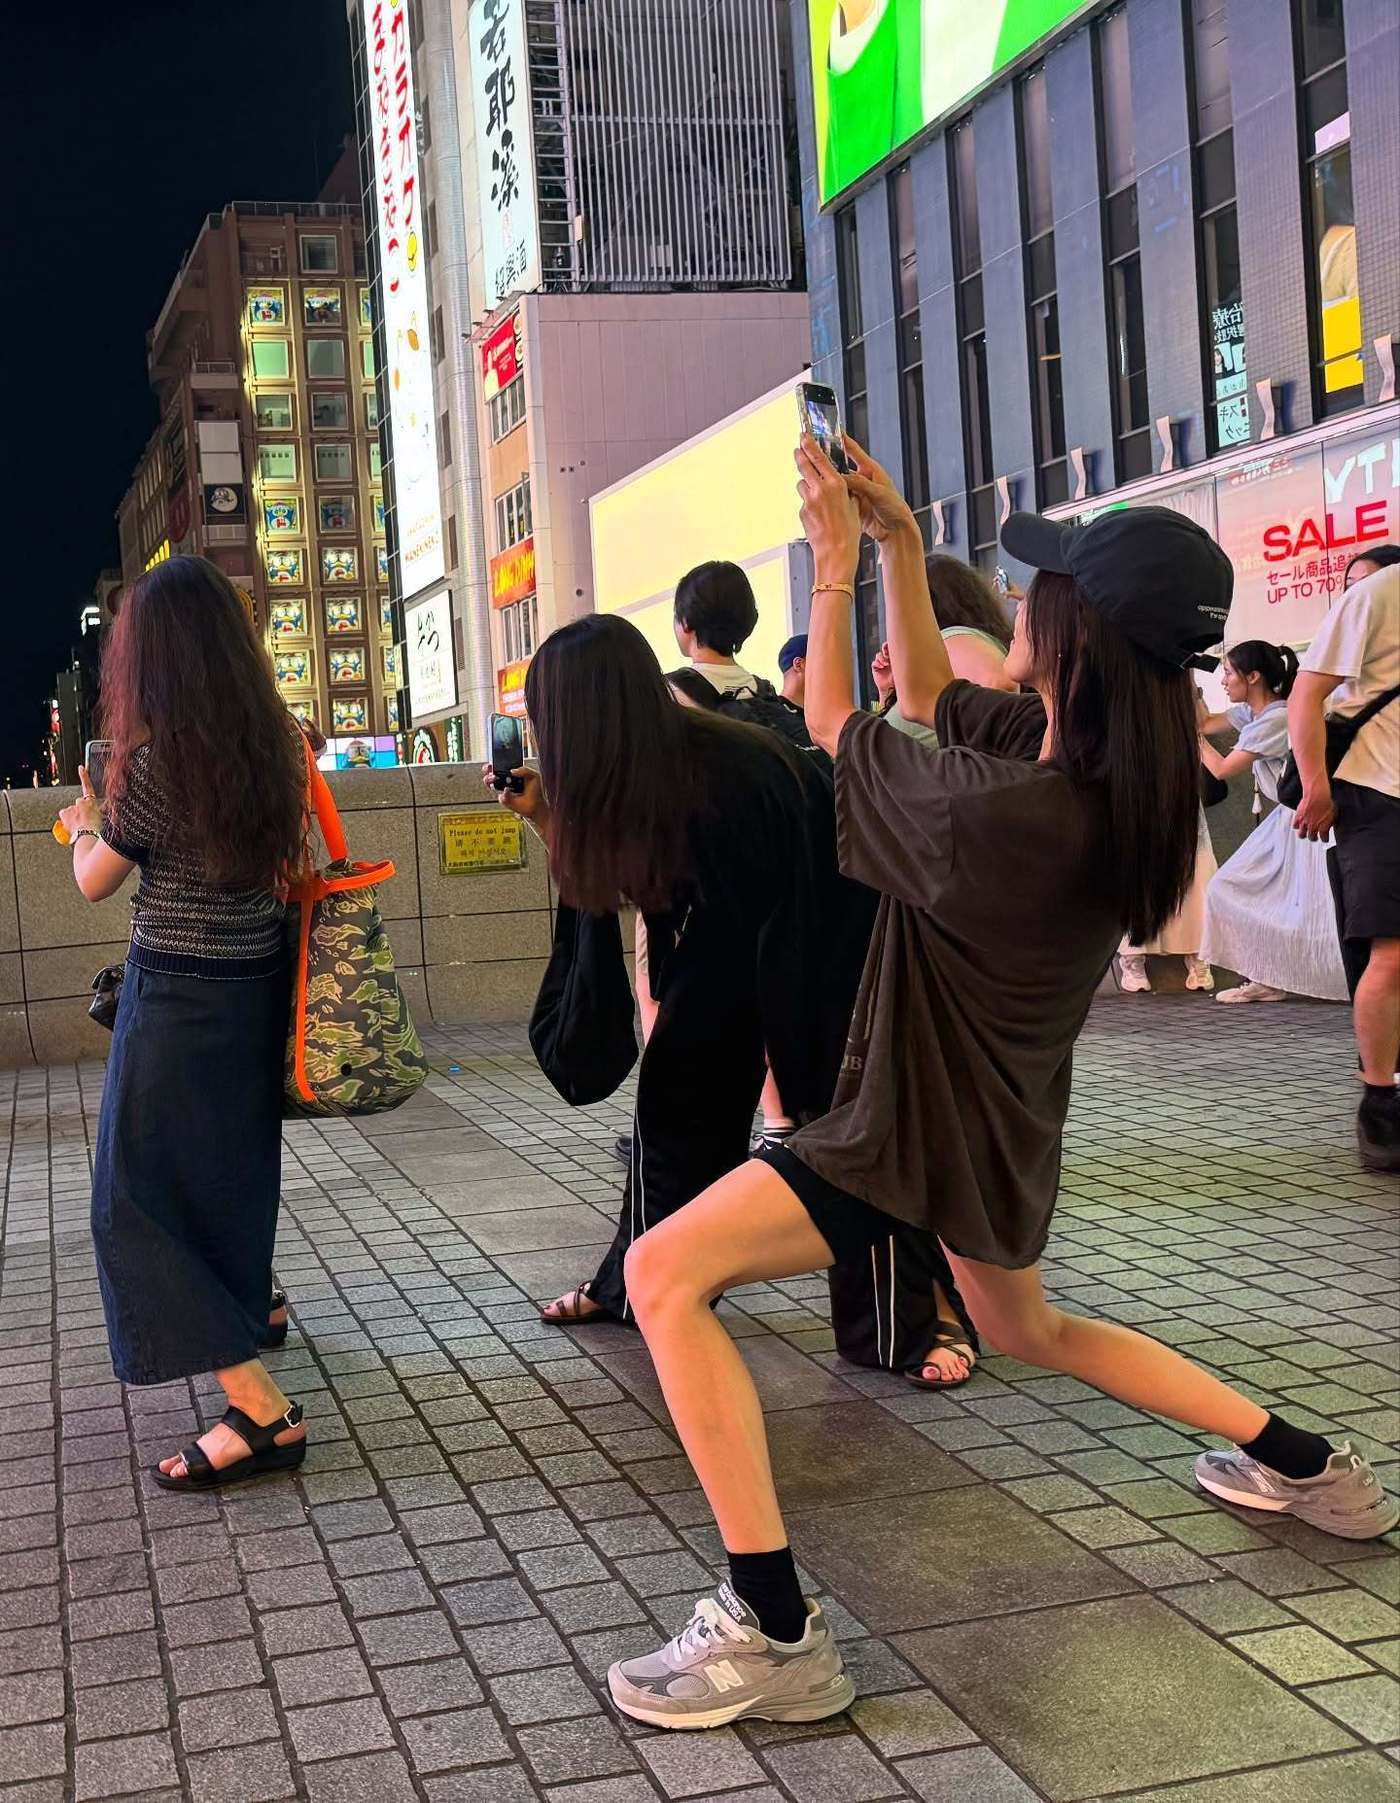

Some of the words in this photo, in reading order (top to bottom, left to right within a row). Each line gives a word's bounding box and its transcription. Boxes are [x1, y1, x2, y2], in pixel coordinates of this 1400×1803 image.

[1263, 500, 1389, 562] SALE
[1267, 587, 1288, 605] UP
[1291, 583, 1313, 600] TO
[703, 1659, 745, 1693] N
